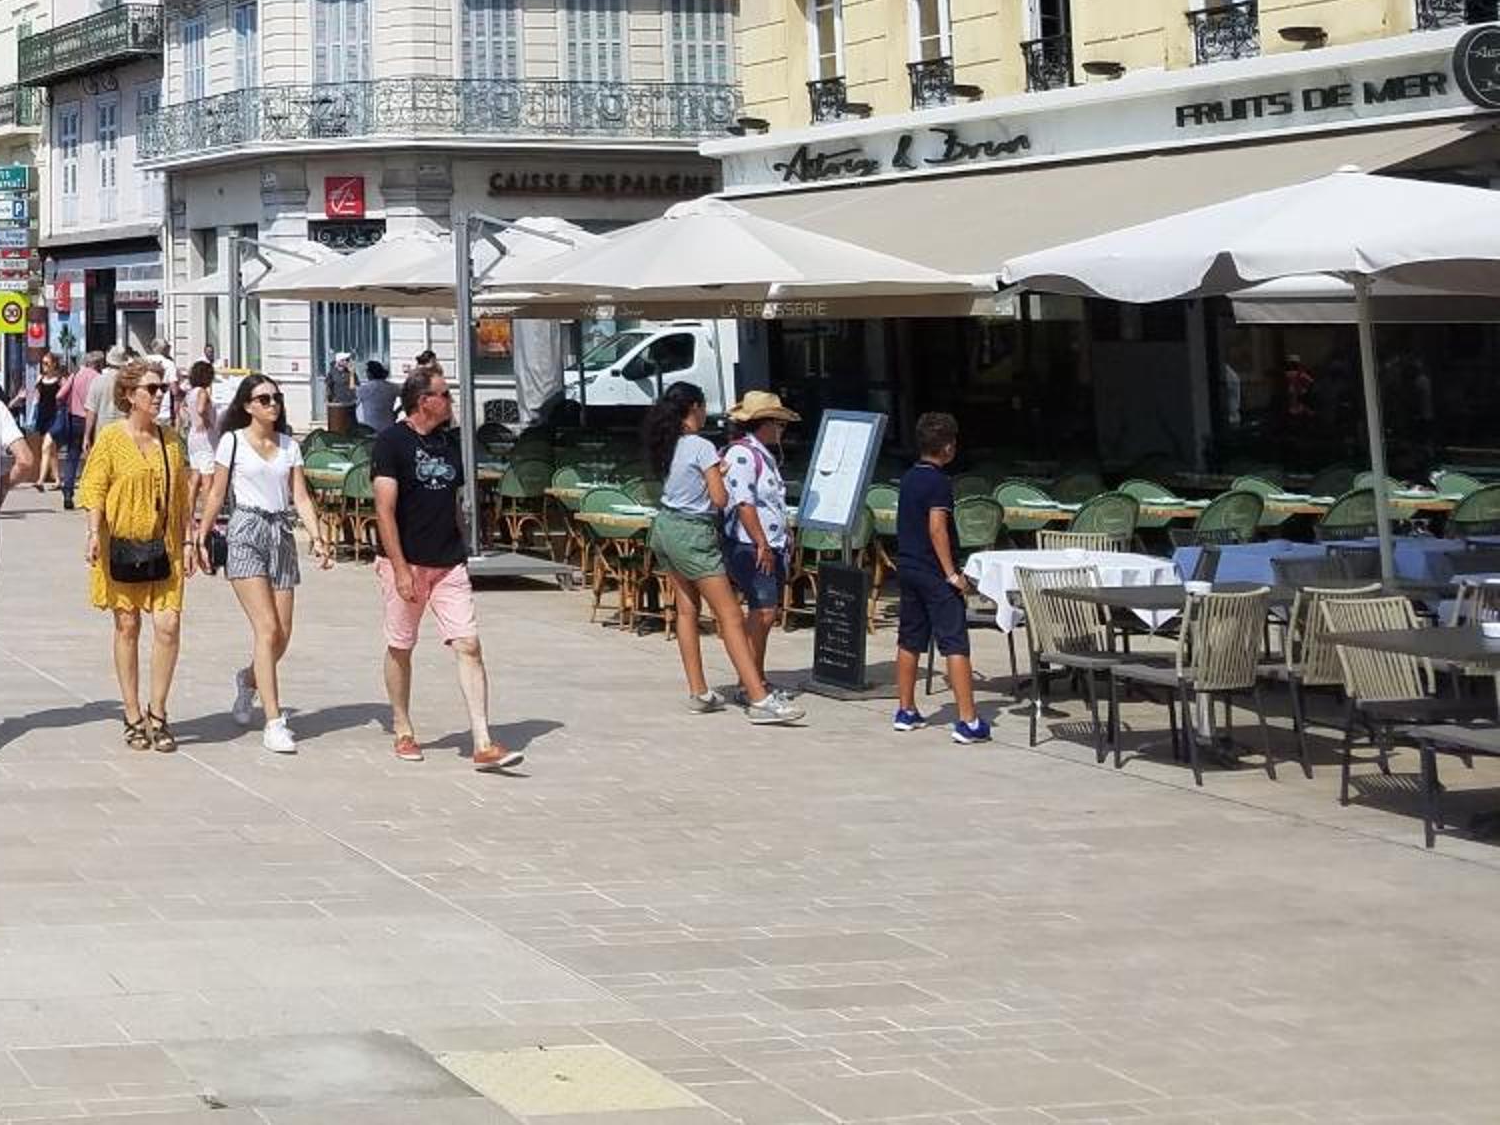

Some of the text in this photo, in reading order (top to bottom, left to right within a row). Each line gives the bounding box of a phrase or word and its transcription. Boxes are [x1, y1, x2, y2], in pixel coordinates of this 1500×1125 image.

[1175, 91, 1292, 128] FRUITS
[1302, 83, 1353, 111] DE
[1363, 73, 1448, 105] MER
[488, 172, 715, 196] CAISSE D'EPARGNE
[721, 301, 829, 318] LA BRASSERIE
